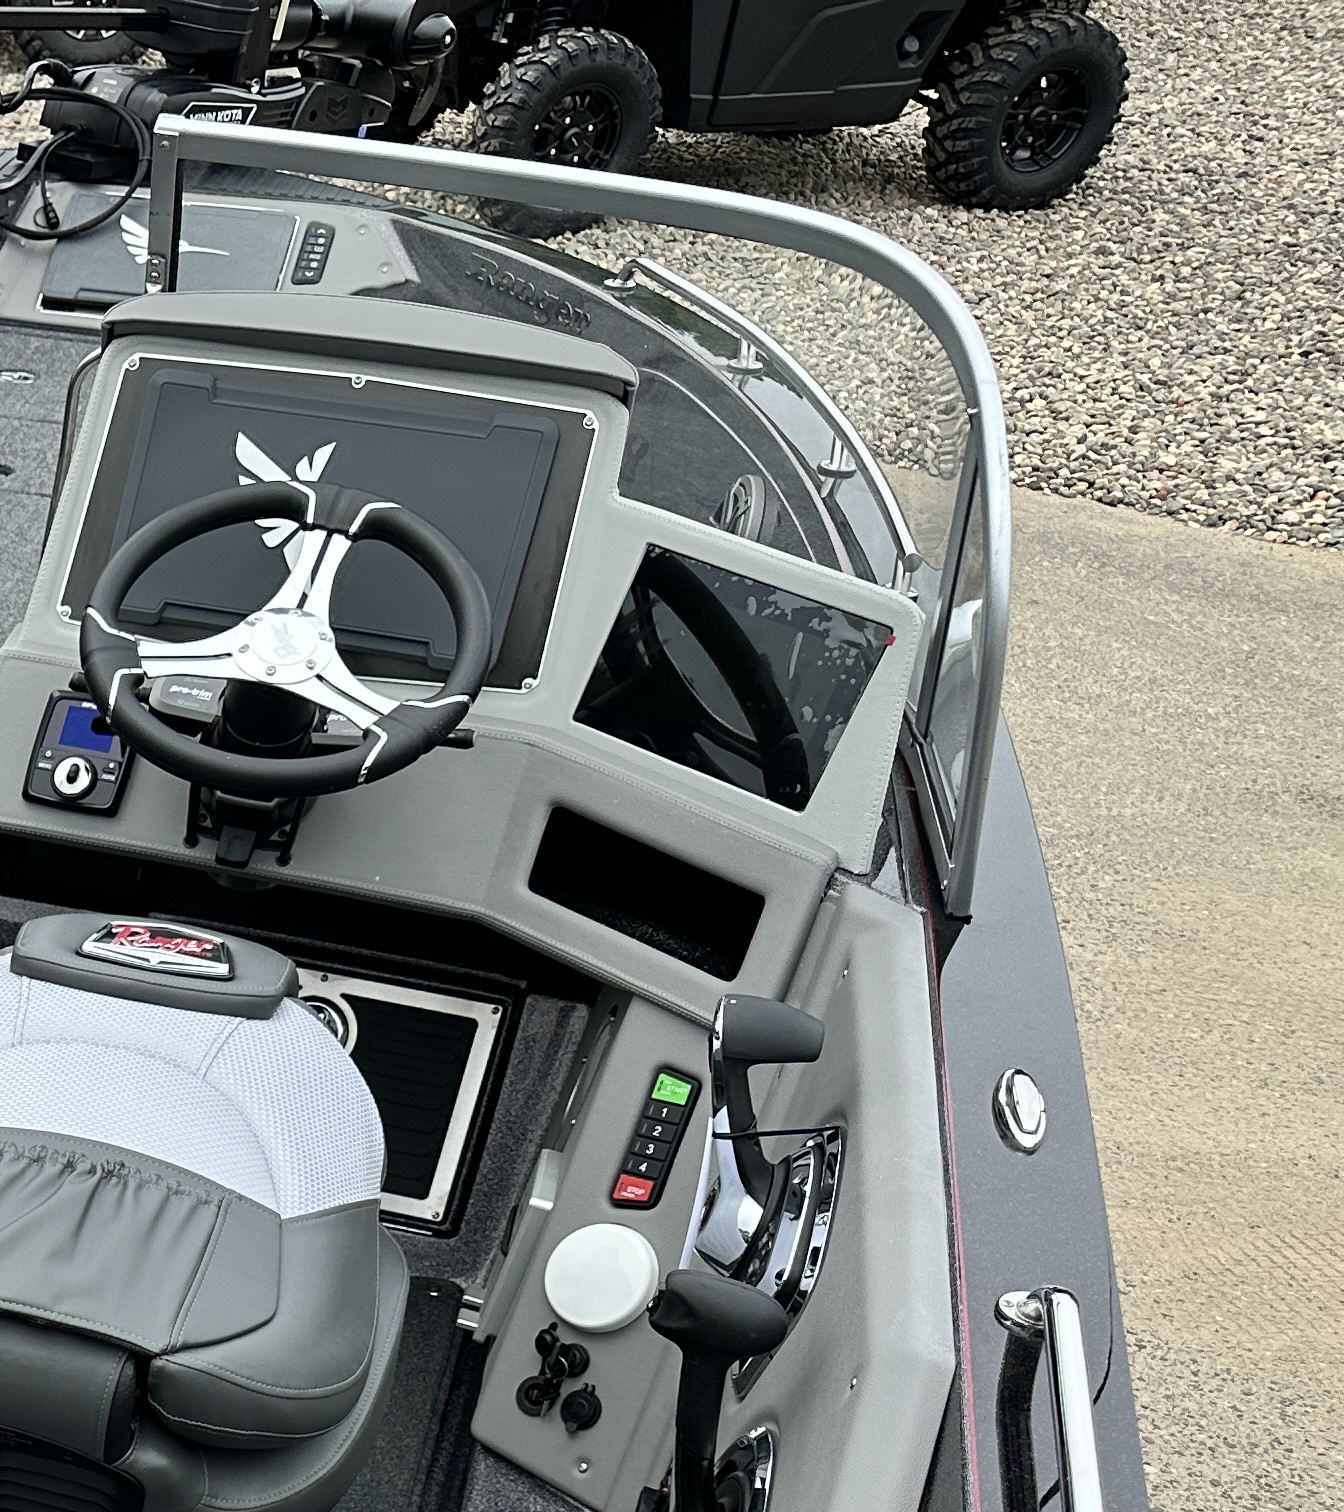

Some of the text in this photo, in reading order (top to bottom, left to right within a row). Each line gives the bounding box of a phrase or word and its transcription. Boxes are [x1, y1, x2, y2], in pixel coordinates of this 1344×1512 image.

[216, 108, 243, 122] KOTA
[465, 251, 591, 335] Ranger
[169, 684, 214, 700] pro-trim
[110, 926, 215, 954] Ranger
[665, 1084, 689, 1095] START
[661, 1106, 668, 1118] 1
[652, 1125, 662, 1137] 2
[645, 1143, 655, 1155] 3
[638, 1161, 648, 1173] 4
[626, 1185, 646, 1196] STOP
